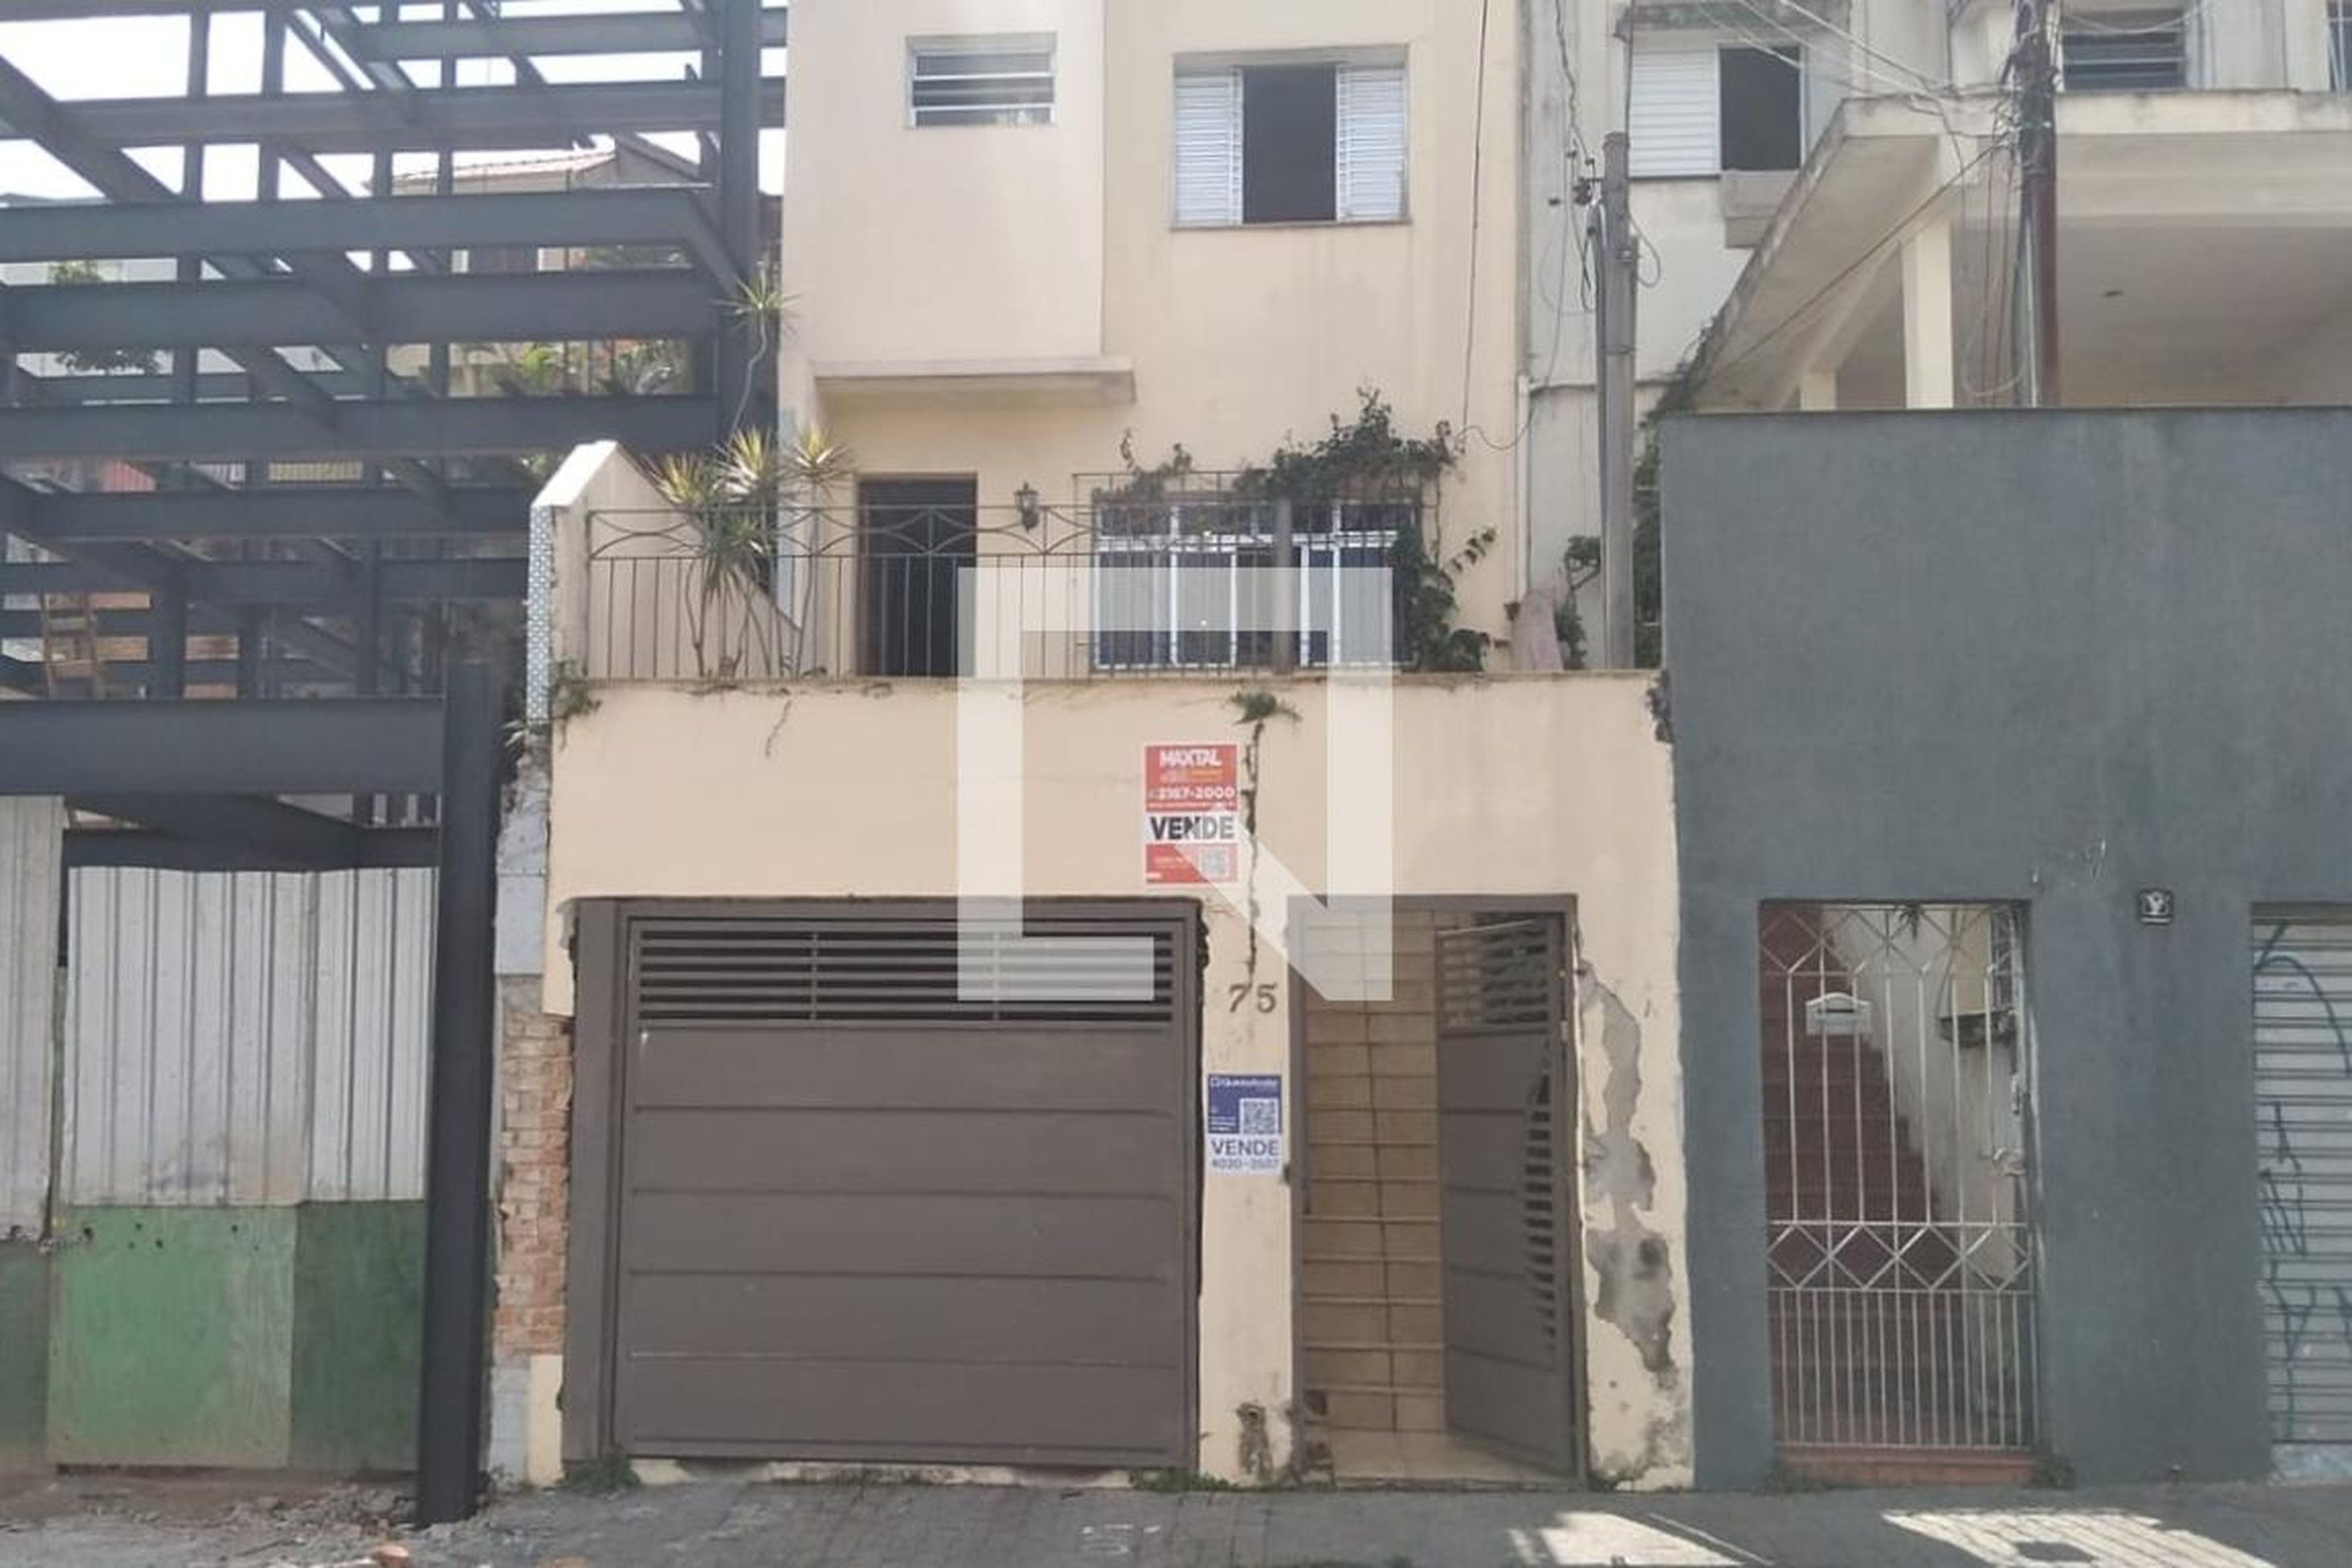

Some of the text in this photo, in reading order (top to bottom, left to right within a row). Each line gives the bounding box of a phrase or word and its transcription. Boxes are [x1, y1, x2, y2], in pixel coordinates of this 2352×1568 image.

[1150, 816, 1235, 840] VENDE
[1229, 982, 1278, 1014] 75
[1211, 1140, 1279, 1156] VENDE
